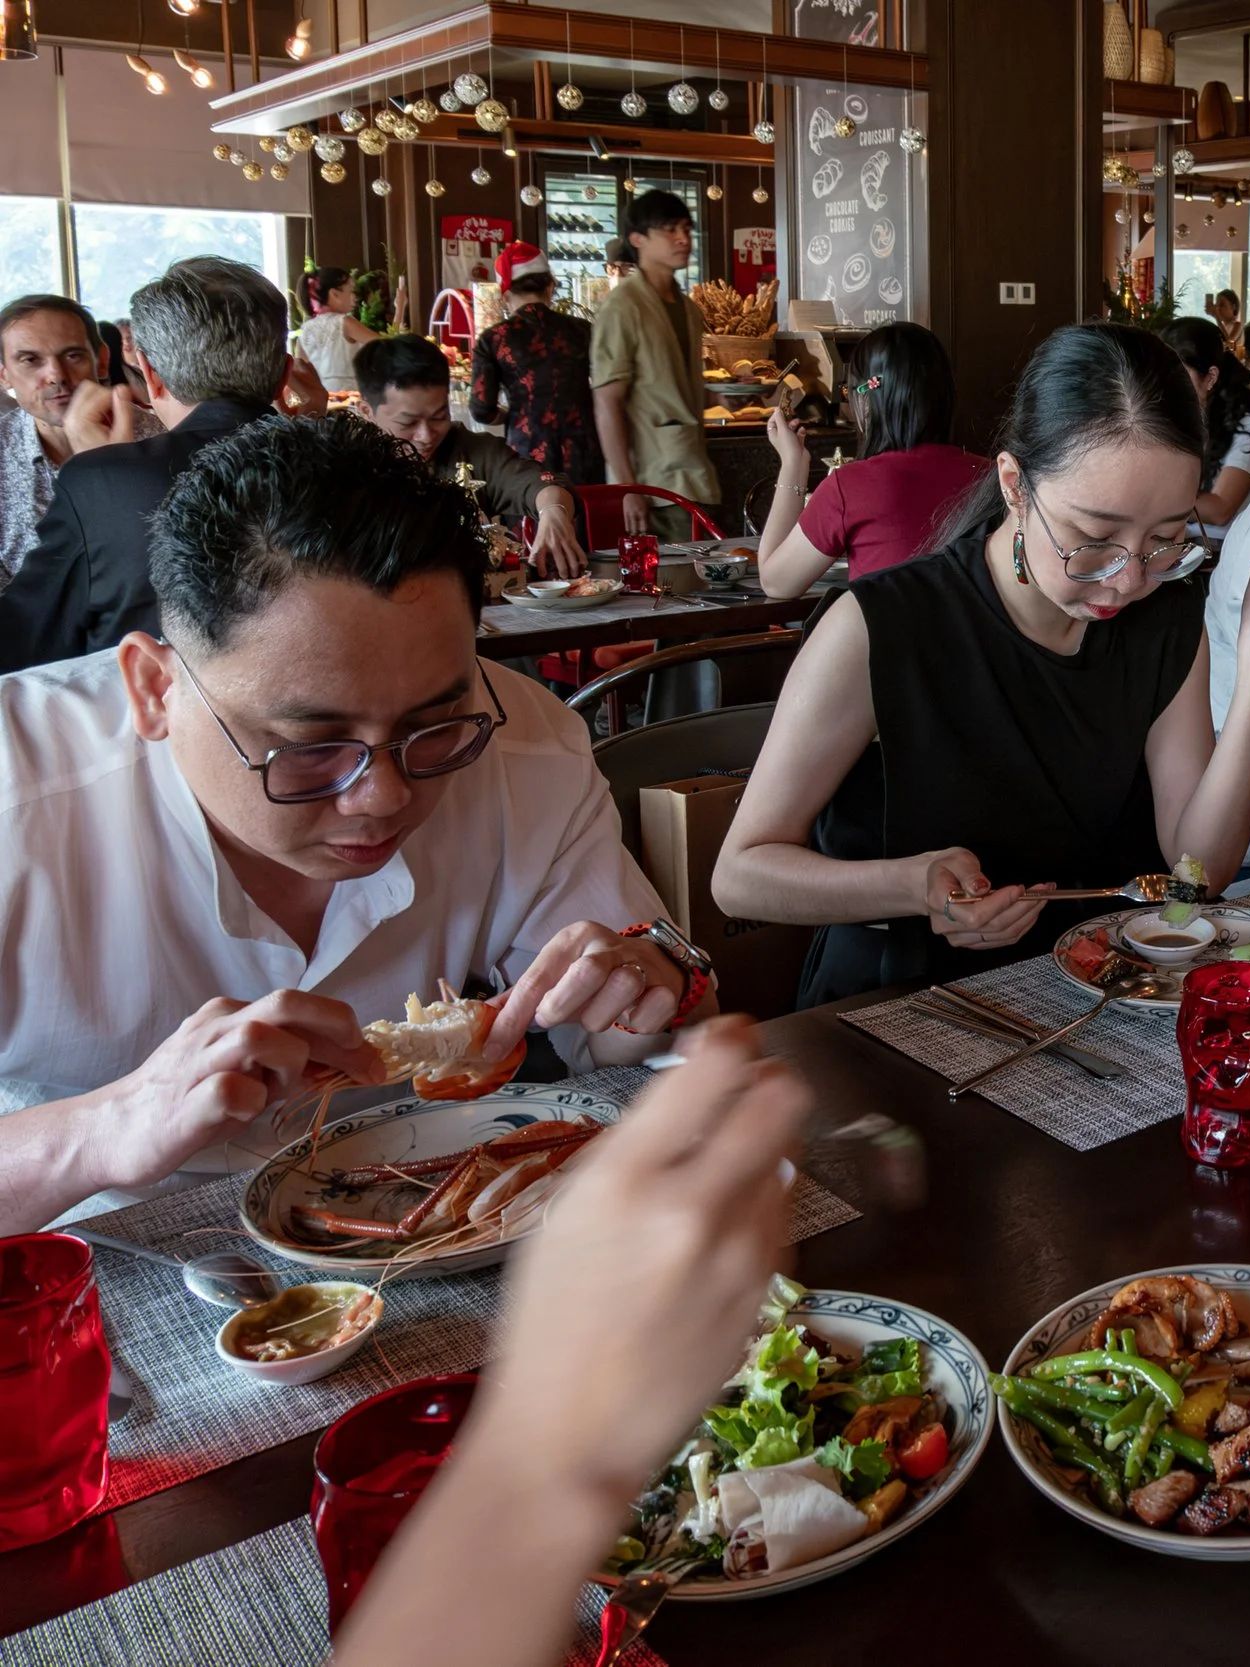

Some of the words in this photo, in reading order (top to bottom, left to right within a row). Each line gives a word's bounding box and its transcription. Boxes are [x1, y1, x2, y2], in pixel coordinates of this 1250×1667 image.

[859, 127, 895, 147] CROISSANT
[825, 199, 859, 217] CHOCOLATE
[829, 217, 855, 233] COOKIES
[863, 309, 897, 325] CUPCAKES
